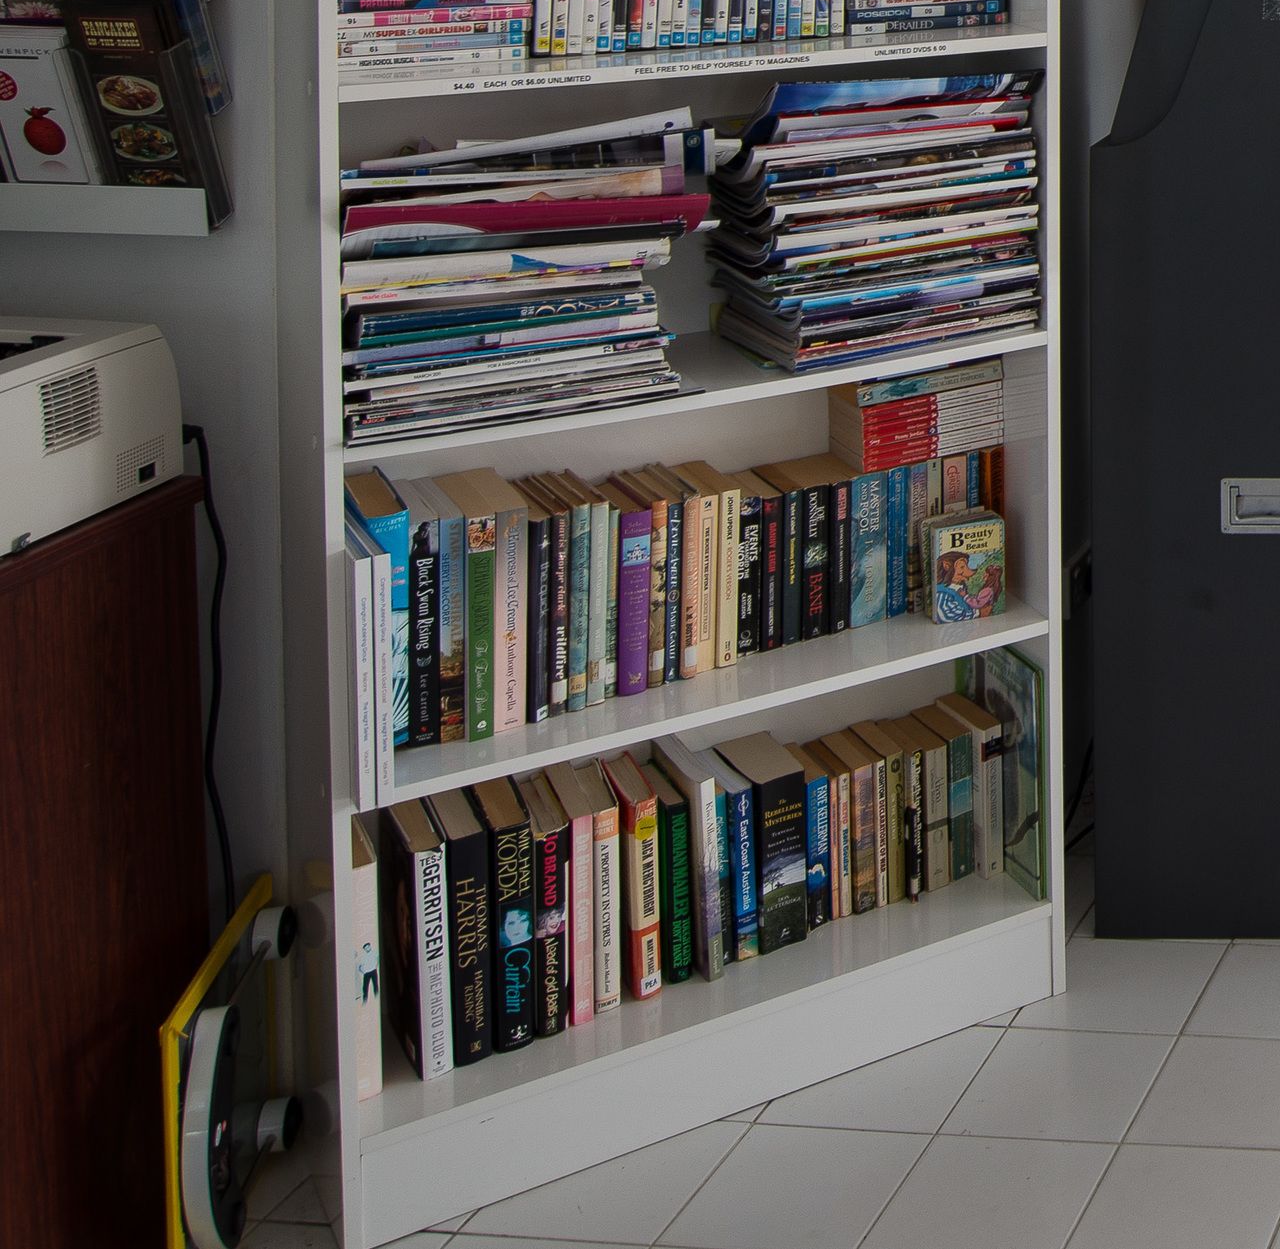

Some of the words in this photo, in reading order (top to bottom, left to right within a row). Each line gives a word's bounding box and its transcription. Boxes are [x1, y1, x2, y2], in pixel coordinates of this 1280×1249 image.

[82, 21, 138, 37] PANCAKES
[857, 9, 911, 19] POSEIDON
[885, 21, 935, 31] DERAILED
[868, 479, 880, 533] MASTER
[950, 527, 994, 549] Beauty
[965, 540, 989, 551] Beast
[416, 557, 434, 583] Black
[416, 584, 434, 616] Swan
[808, 572, 825, 617] BANE
[415, 617, 434, 651] Rising
[816, 784, 828, 807] FAYE
[740, 818, 750, 842] East
[817, 807, 828, 857] KELLERMAN
[496, 831, 519, 902] KORDA
[518, 828, 530, 895] MICHAEL
[741, 843, 751, 867] Coast
[742, 869, 752, 912] Australia
[424, 863, 444, 962] GERRITSEN
[456, 877, 477, 969] HARRIS
[475, 883, 488, 952] THOMAS
[504, 947, 531, 1014] Curtain
